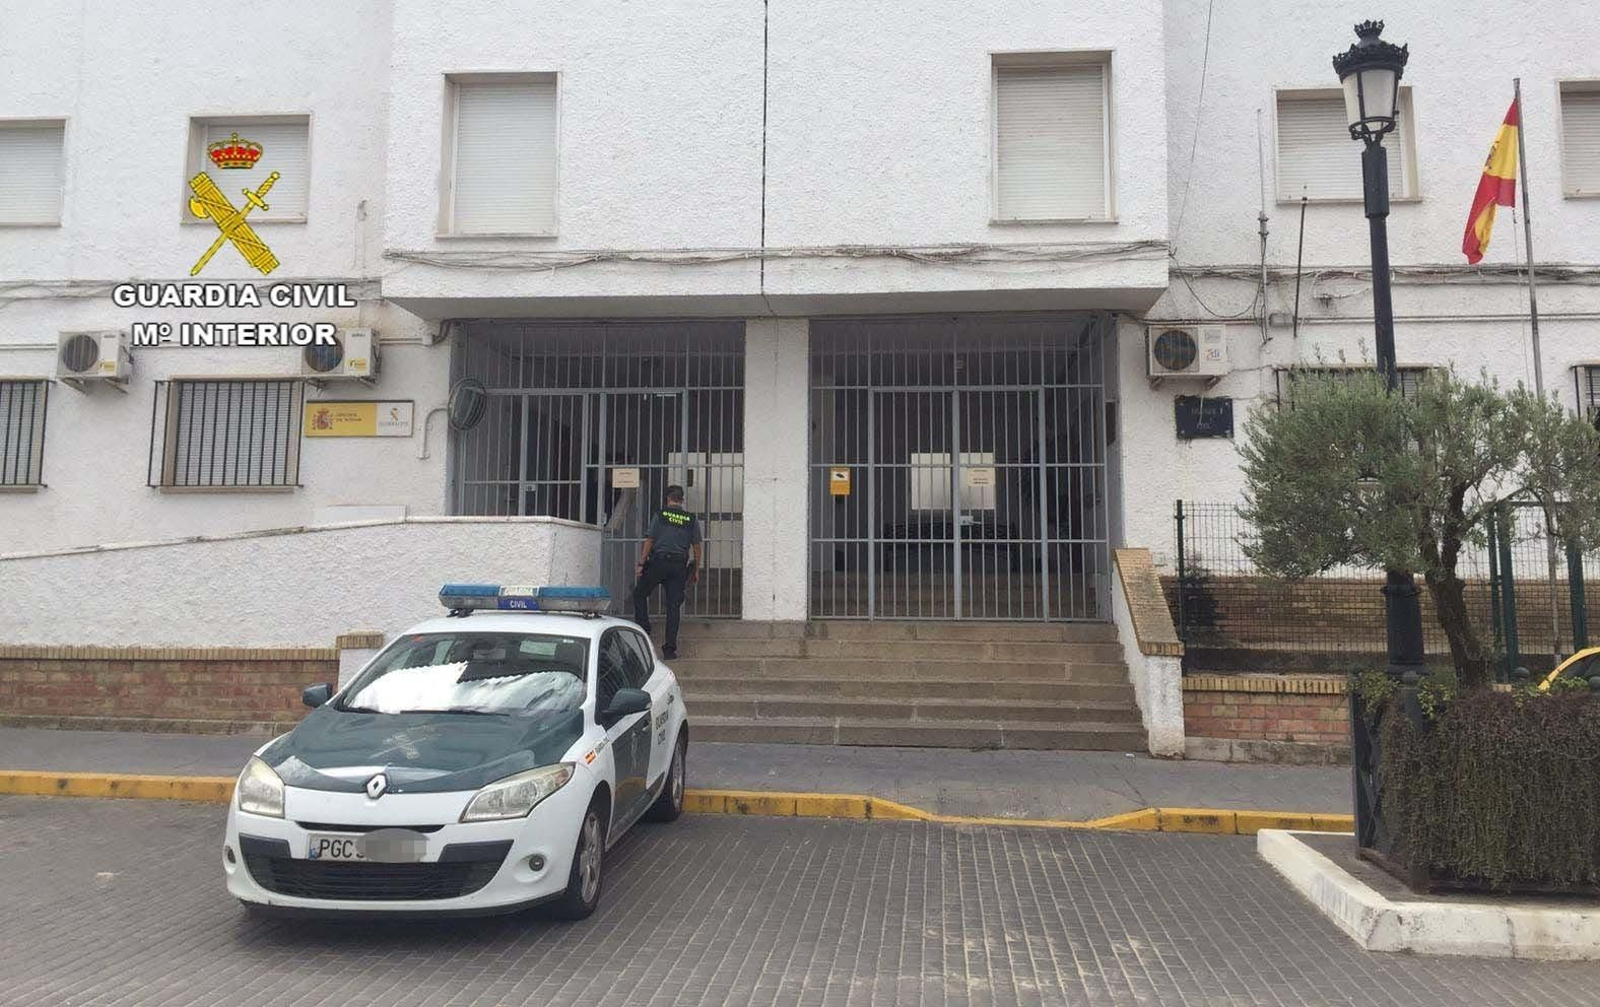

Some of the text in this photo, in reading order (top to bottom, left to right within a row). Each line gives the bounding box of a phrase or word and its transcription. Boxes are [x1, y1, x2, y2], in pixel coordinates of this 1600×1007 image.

[662, 511, 691, 521] GUARDIA
[669, 517, 683, 525] CIVIL
[510, 600, 528, 609] CIVIL
